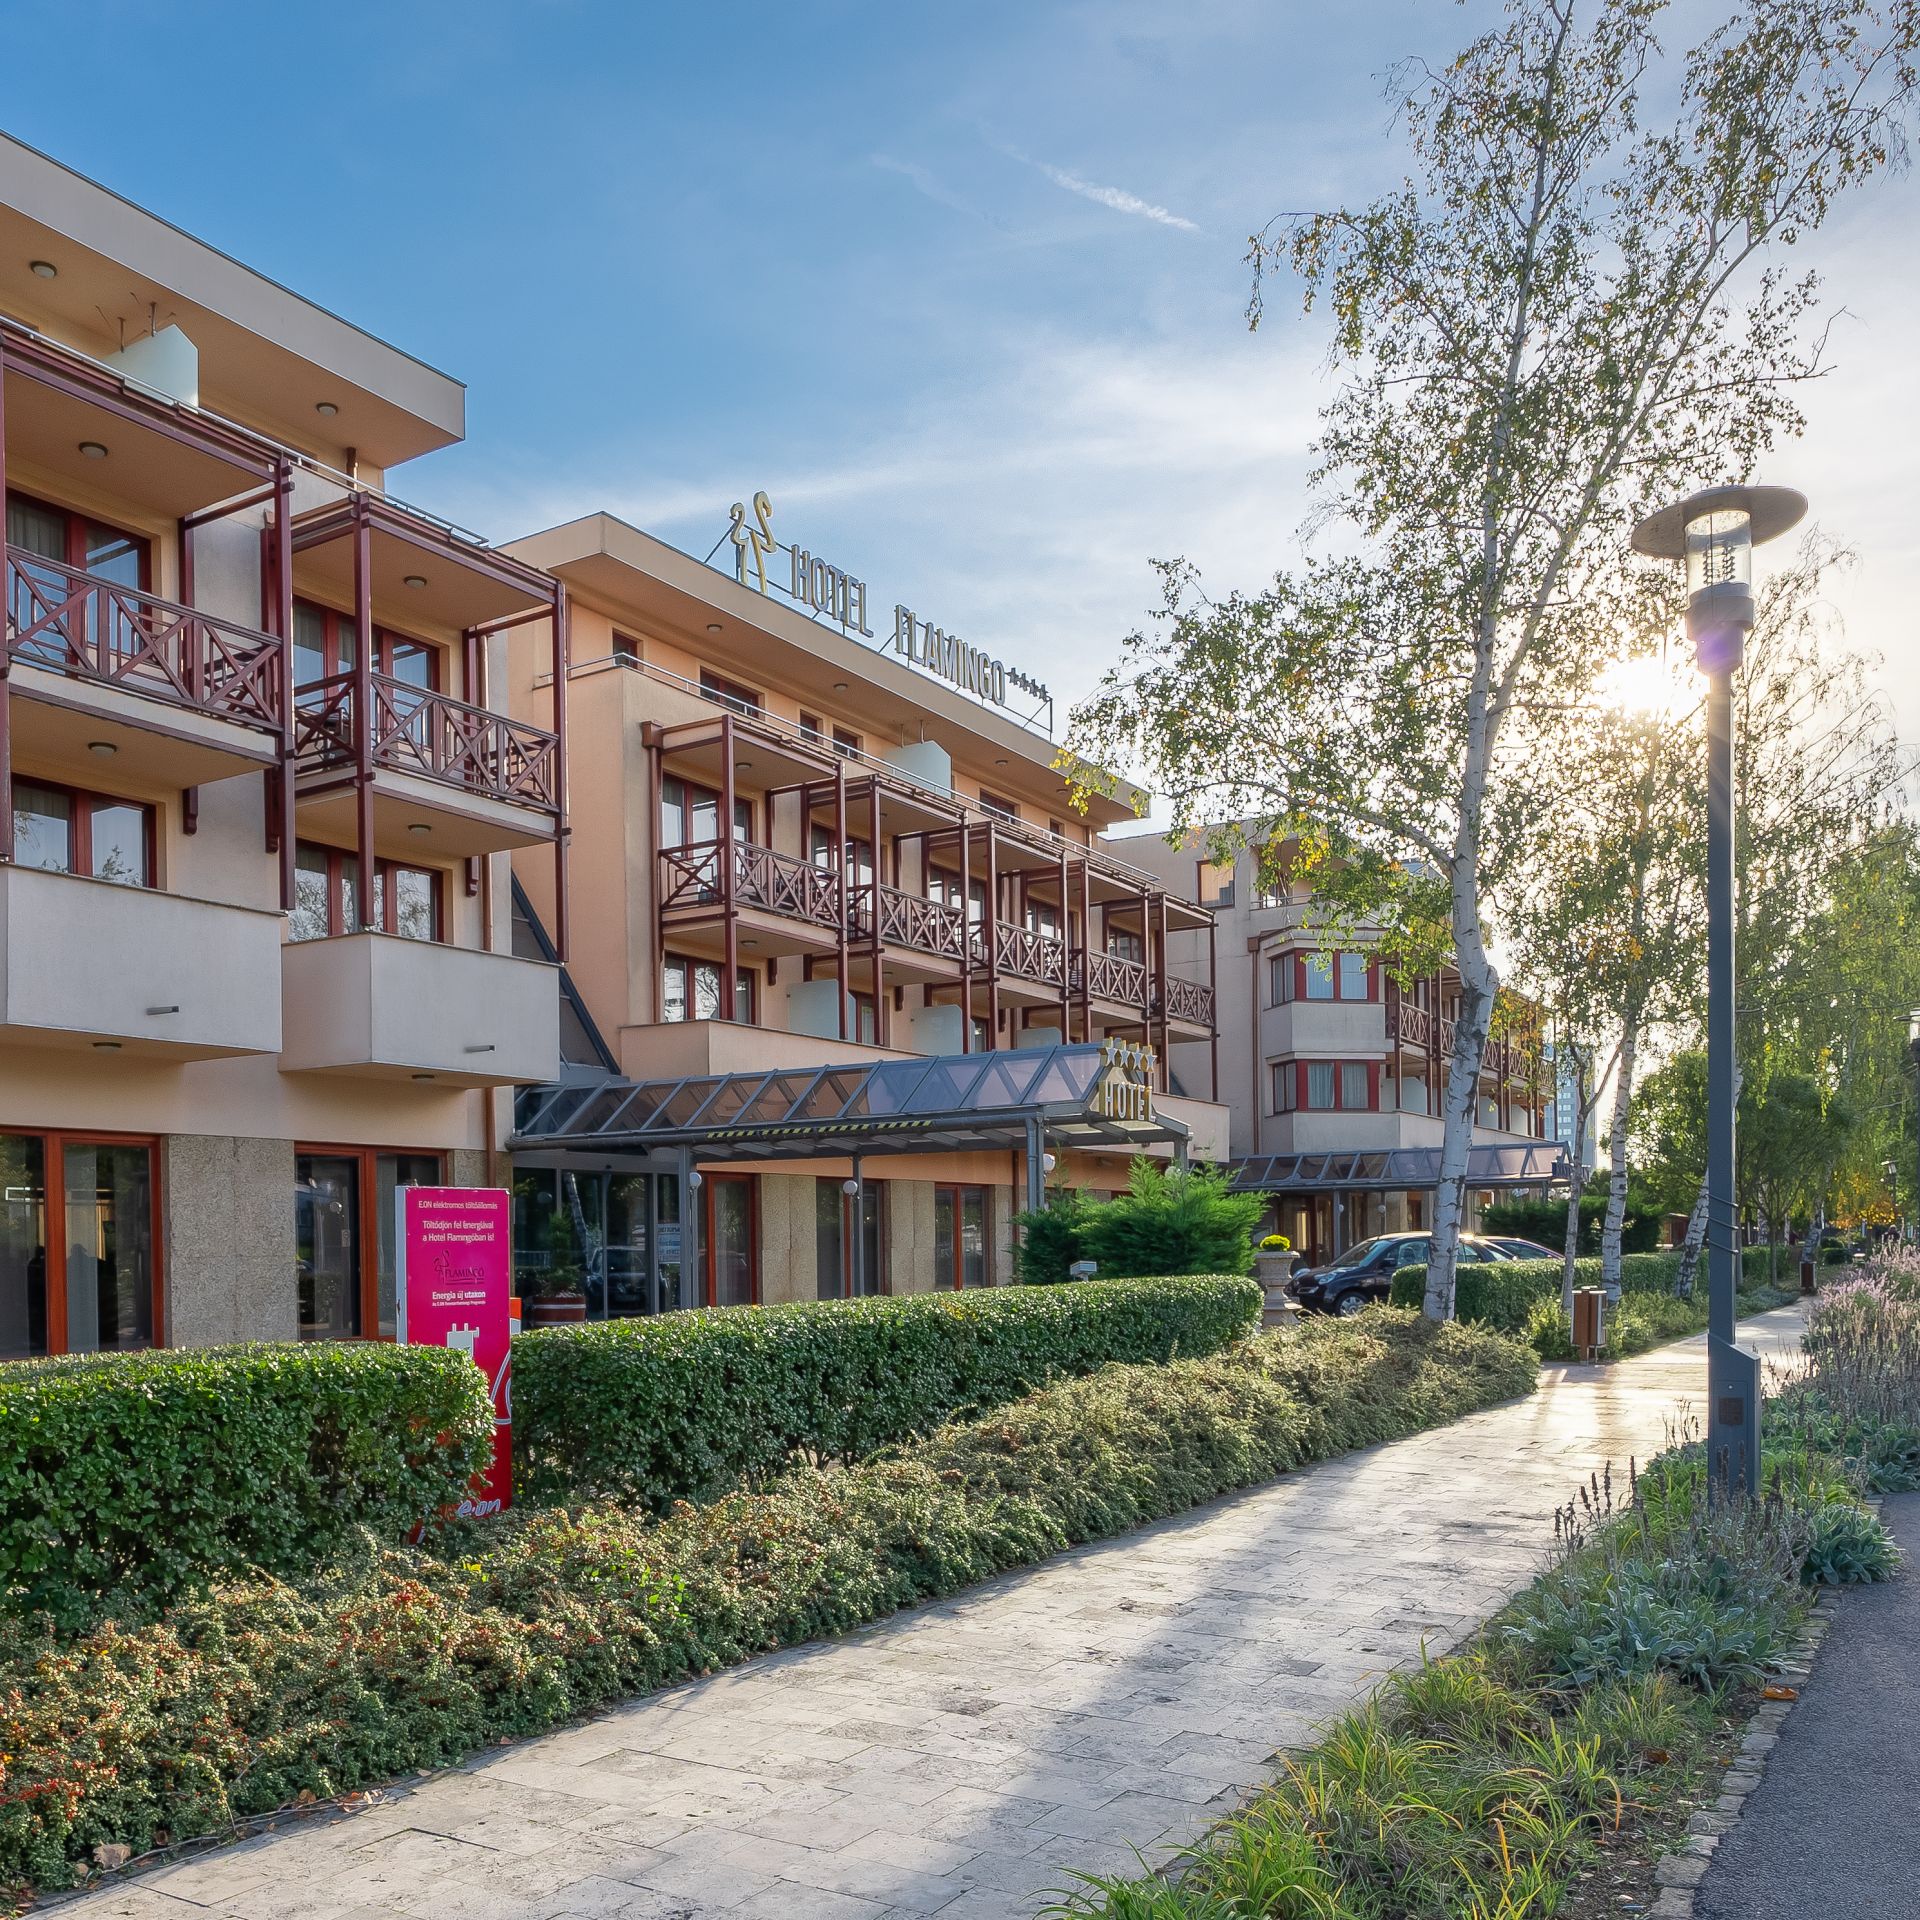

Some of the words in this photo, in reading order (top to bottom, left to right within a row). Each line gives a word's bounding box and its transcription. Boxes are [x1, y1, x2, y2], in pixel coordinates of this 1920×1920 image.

[791, 544, 874, 638] HOTEL
[895, 604, 1006, 706] FLAMINGO
[1103, 1080, 1157, 1122] HOTEL
[453, 1220, 462, 1229] fel
[428, 1233, 446, 1242] Hotel
[432, 1291, 456, 1301] Energia
